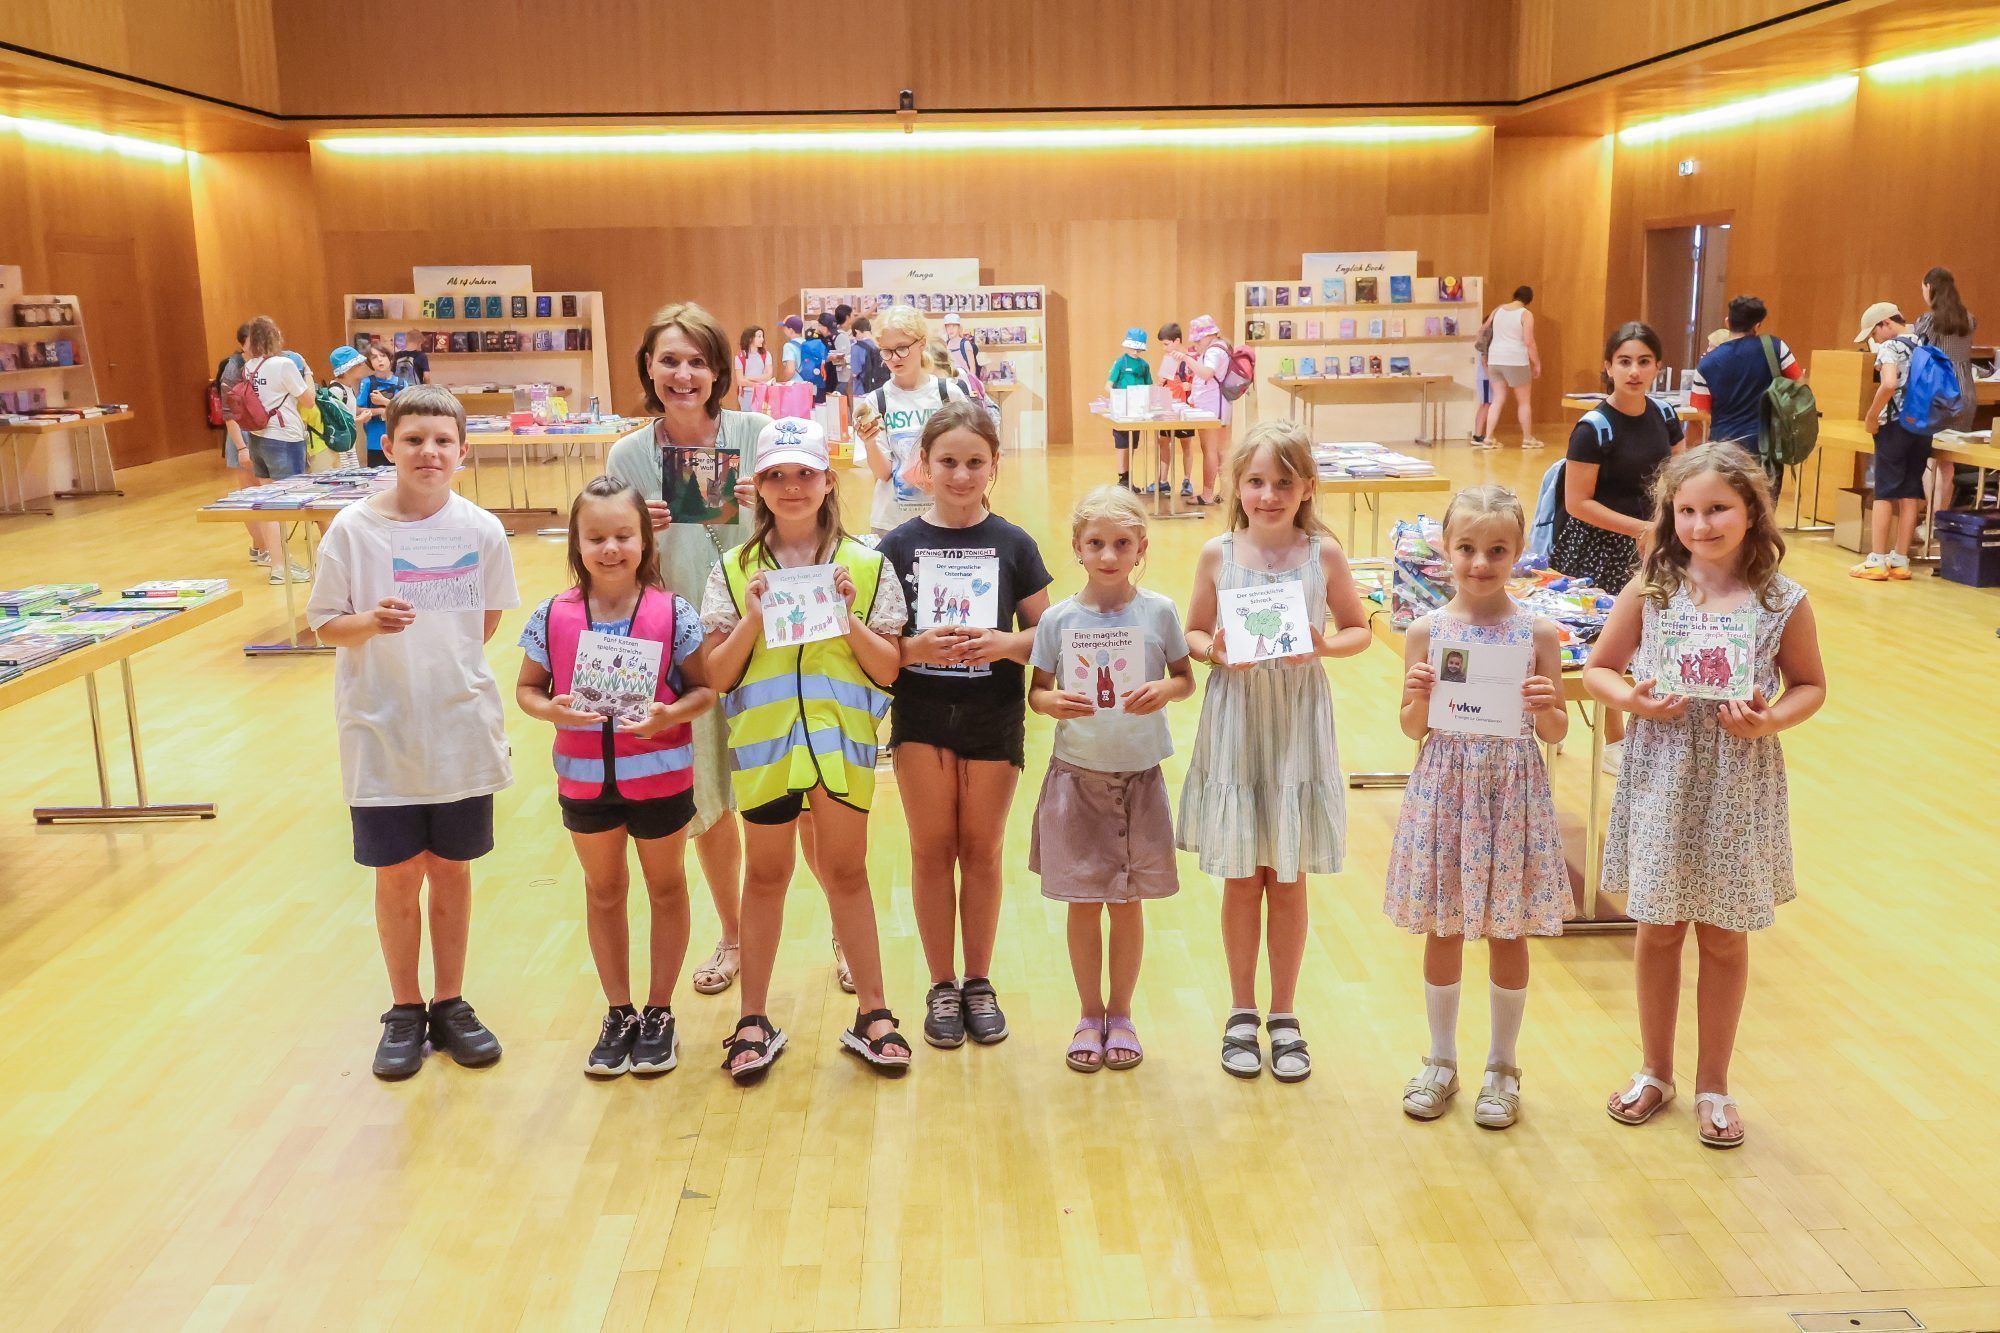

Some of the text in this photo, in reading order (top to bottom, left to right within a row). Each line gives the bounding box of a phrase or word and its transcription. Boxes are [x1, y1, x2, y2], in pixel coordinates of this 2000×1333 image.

[1335, 263, 1363, 275] English
[906, 269, 934, 281] Manga
[446, 277, 458, 286] Ab
[468, 277, 497, 286] Jahren
[884, 410, 913, 430] AISY
[1679, 612, 1698, 621] drei
[1701, 613, 1732, 623] Bären
[1661, 620, 1688, 629] treffen
[1691, 623, 1707, 631] sich
[1074, 630, 1129, 640] Eine magische
[1661, 629, 1691, 637] wieder
[603, 636, 639, 647] Fünf Katzen
[1071, 639, 1133, 649] Ostergeschichte
[596, 644, 643, 655] spielen Streiche
[1456, 702, 1482, 714] vkw
